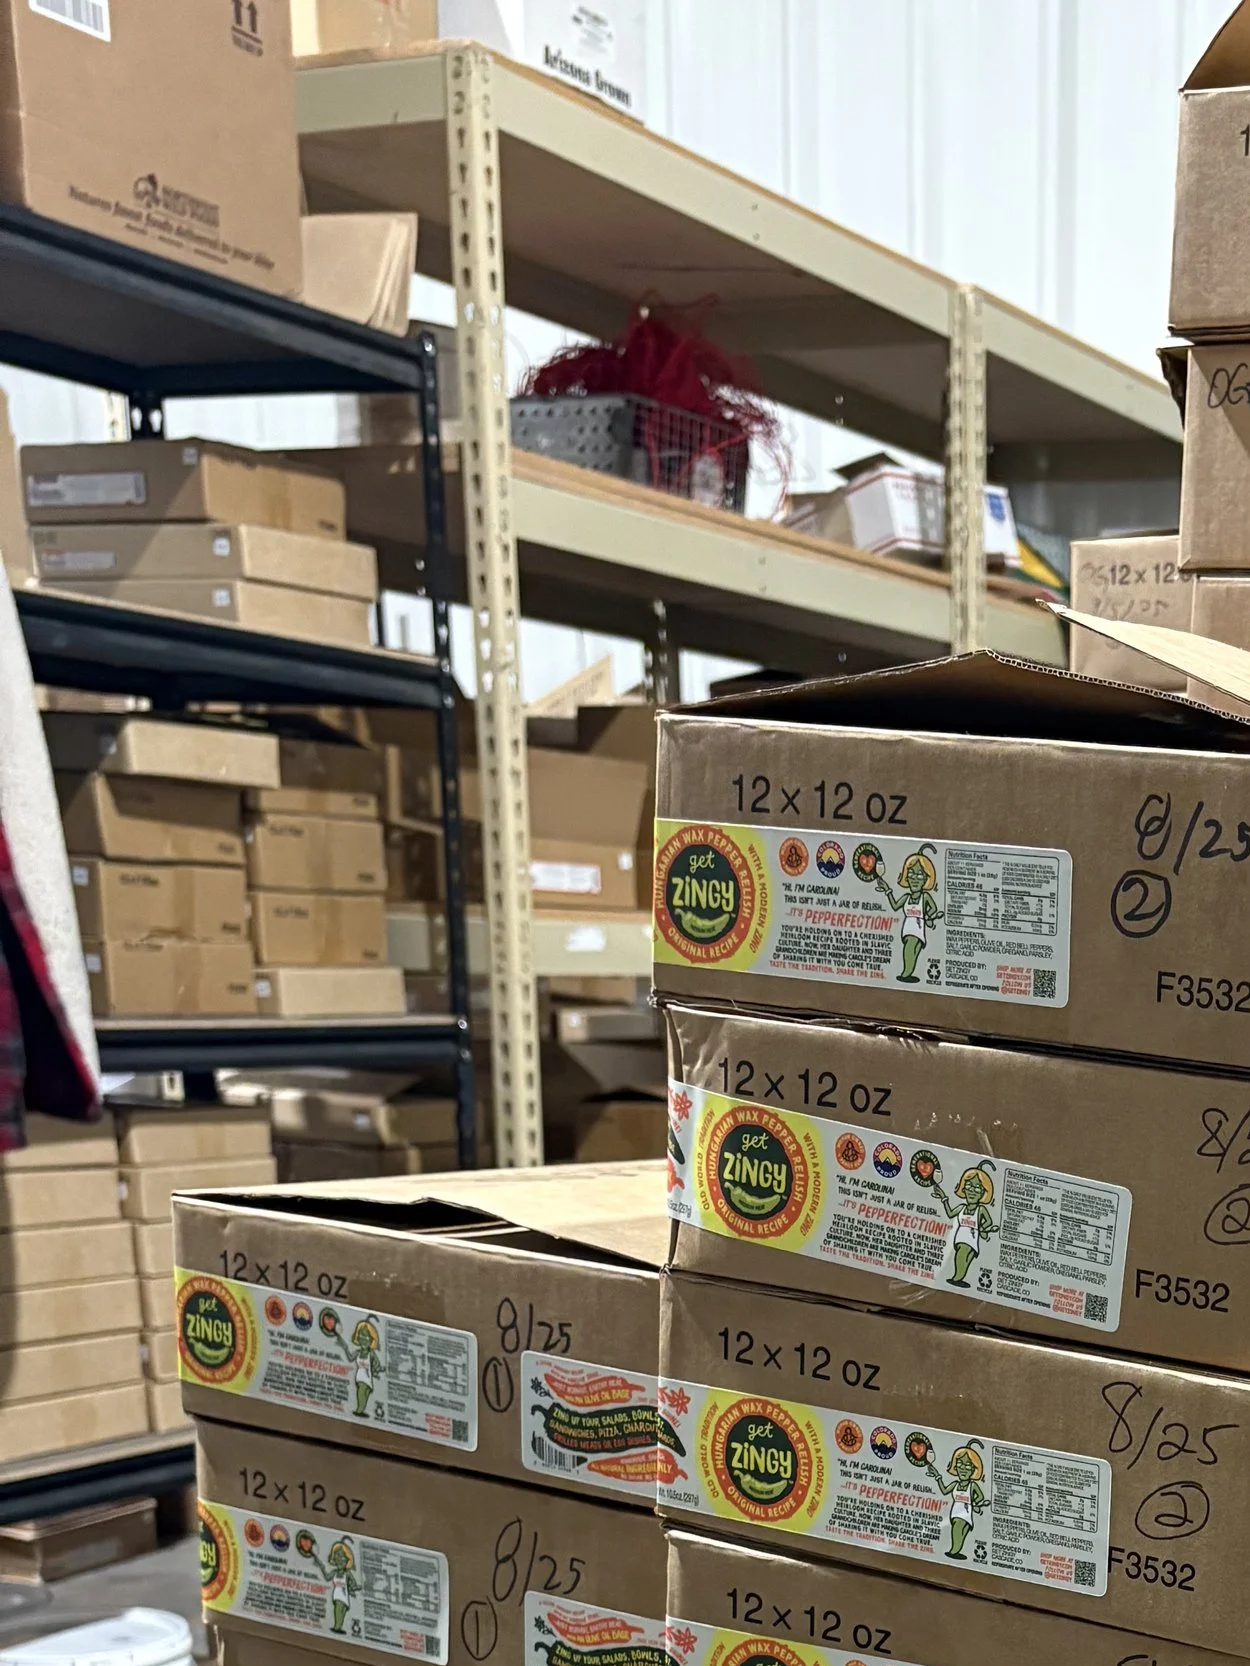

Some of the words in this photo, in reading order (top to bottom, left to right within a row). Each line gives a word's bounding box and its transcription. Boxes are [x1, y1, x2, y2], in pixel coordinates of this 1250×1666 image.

[732, 774, 771, 813] 12
[780, 786, 801, 815] x
[814, 780, 853, 820] 12
[866, 793, 908, 825] oz
[689, 851, 715, 874] get
[718, 1057, 755, 1096] 12
[764, 1072, 785, 1100] x
[798, 1068, 838, 1108] 12
[850, 1083, 892, 1117] oz
[742, 1132, 768, 1151] get
[219, 1250, 247, 1282] 12
[279, 1262, 308, 1292] 12
[318, 1271, 348, 1298] oz
[1134, 1268, 1230, 1313] F3532
[718, 1327, 754, 1365] 12
[763, 1344, 783, 1370] x
[794, 1342, 831, 1381] 12
[842, 1359, 881, 1392] oz
[1102, 1381, 1240, 1470] 8/25
[1109, 1547, 1196, 1592] F3532
[727, 1588, 764, 1624] 12
[772, 1606, 792, 1630] x
[804, 1606, 841, 1643] 12
[853, 1624, 892, 1654] oz
